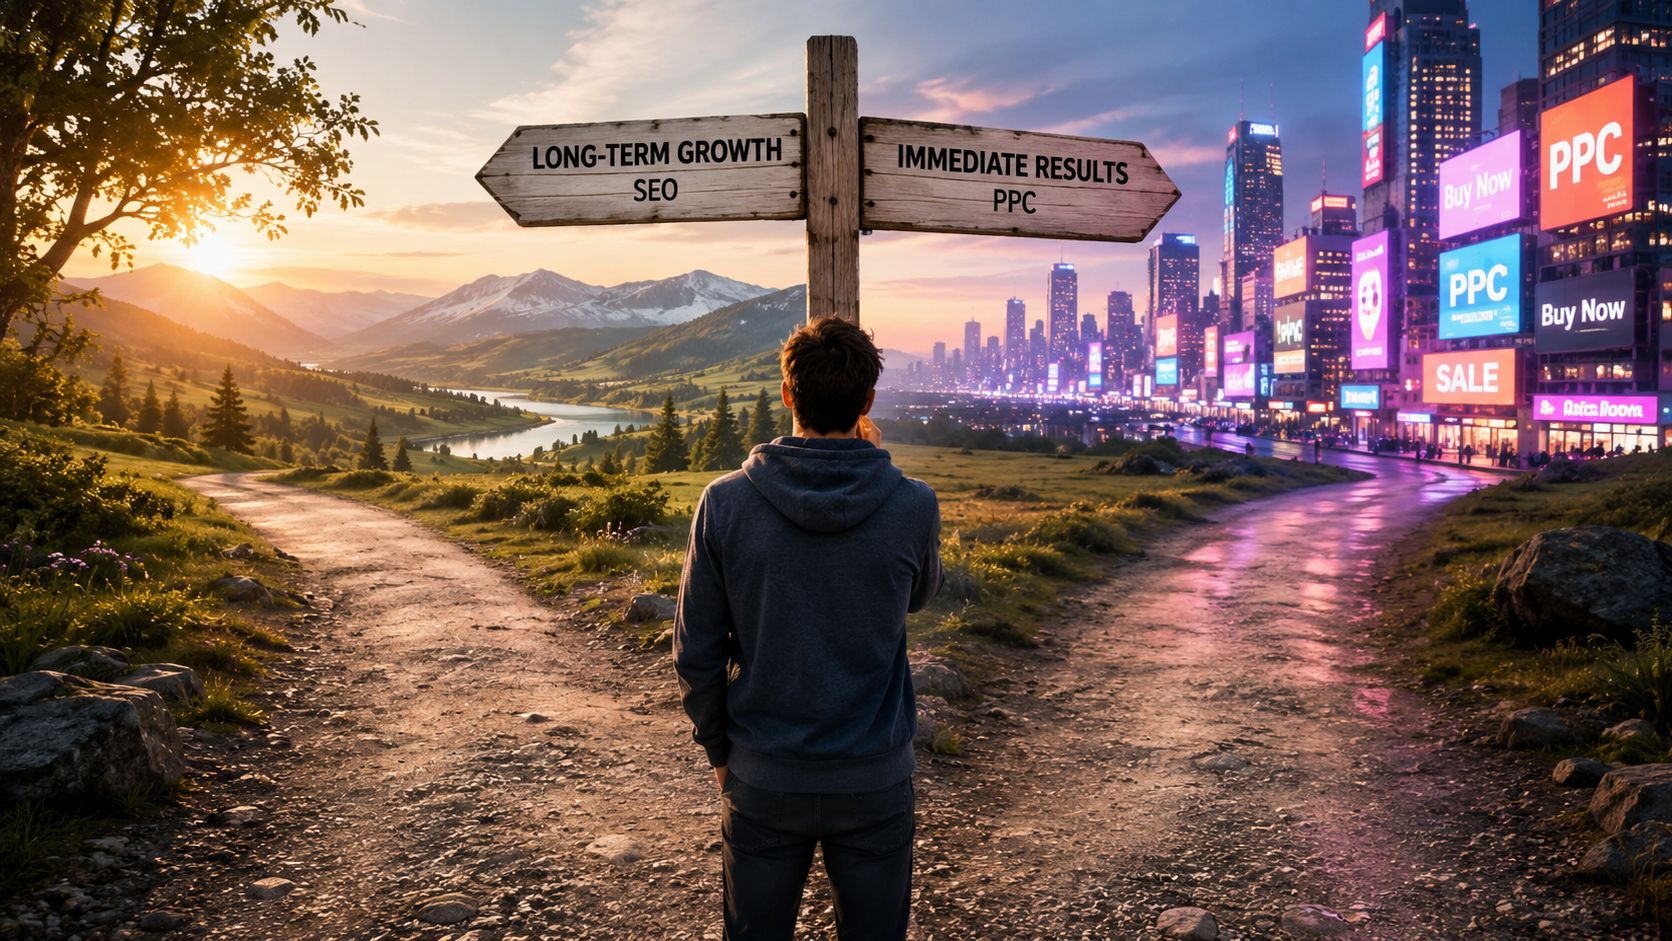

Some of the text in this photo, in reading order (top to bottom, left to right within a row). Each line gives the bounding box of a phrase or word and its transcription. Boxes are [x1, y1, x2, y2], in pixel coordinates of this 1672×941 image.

[532, 137, 782, 170] LONG-TERM GROWTH
[898, 144, 1129, 185] IMMEDIATE RESULTS
[1549, 121, 1622, 191] PPC
[633, 178, 678, 202] SEO
[993, 188, 1037, 214] PPC
[1444, 168, 1513, 210] Buy Now
[1450, 263, 1508, 307] PPC
[1541, 298, 1626, 331] Buy Now
[1436, 362, 1499, 393] SALE
